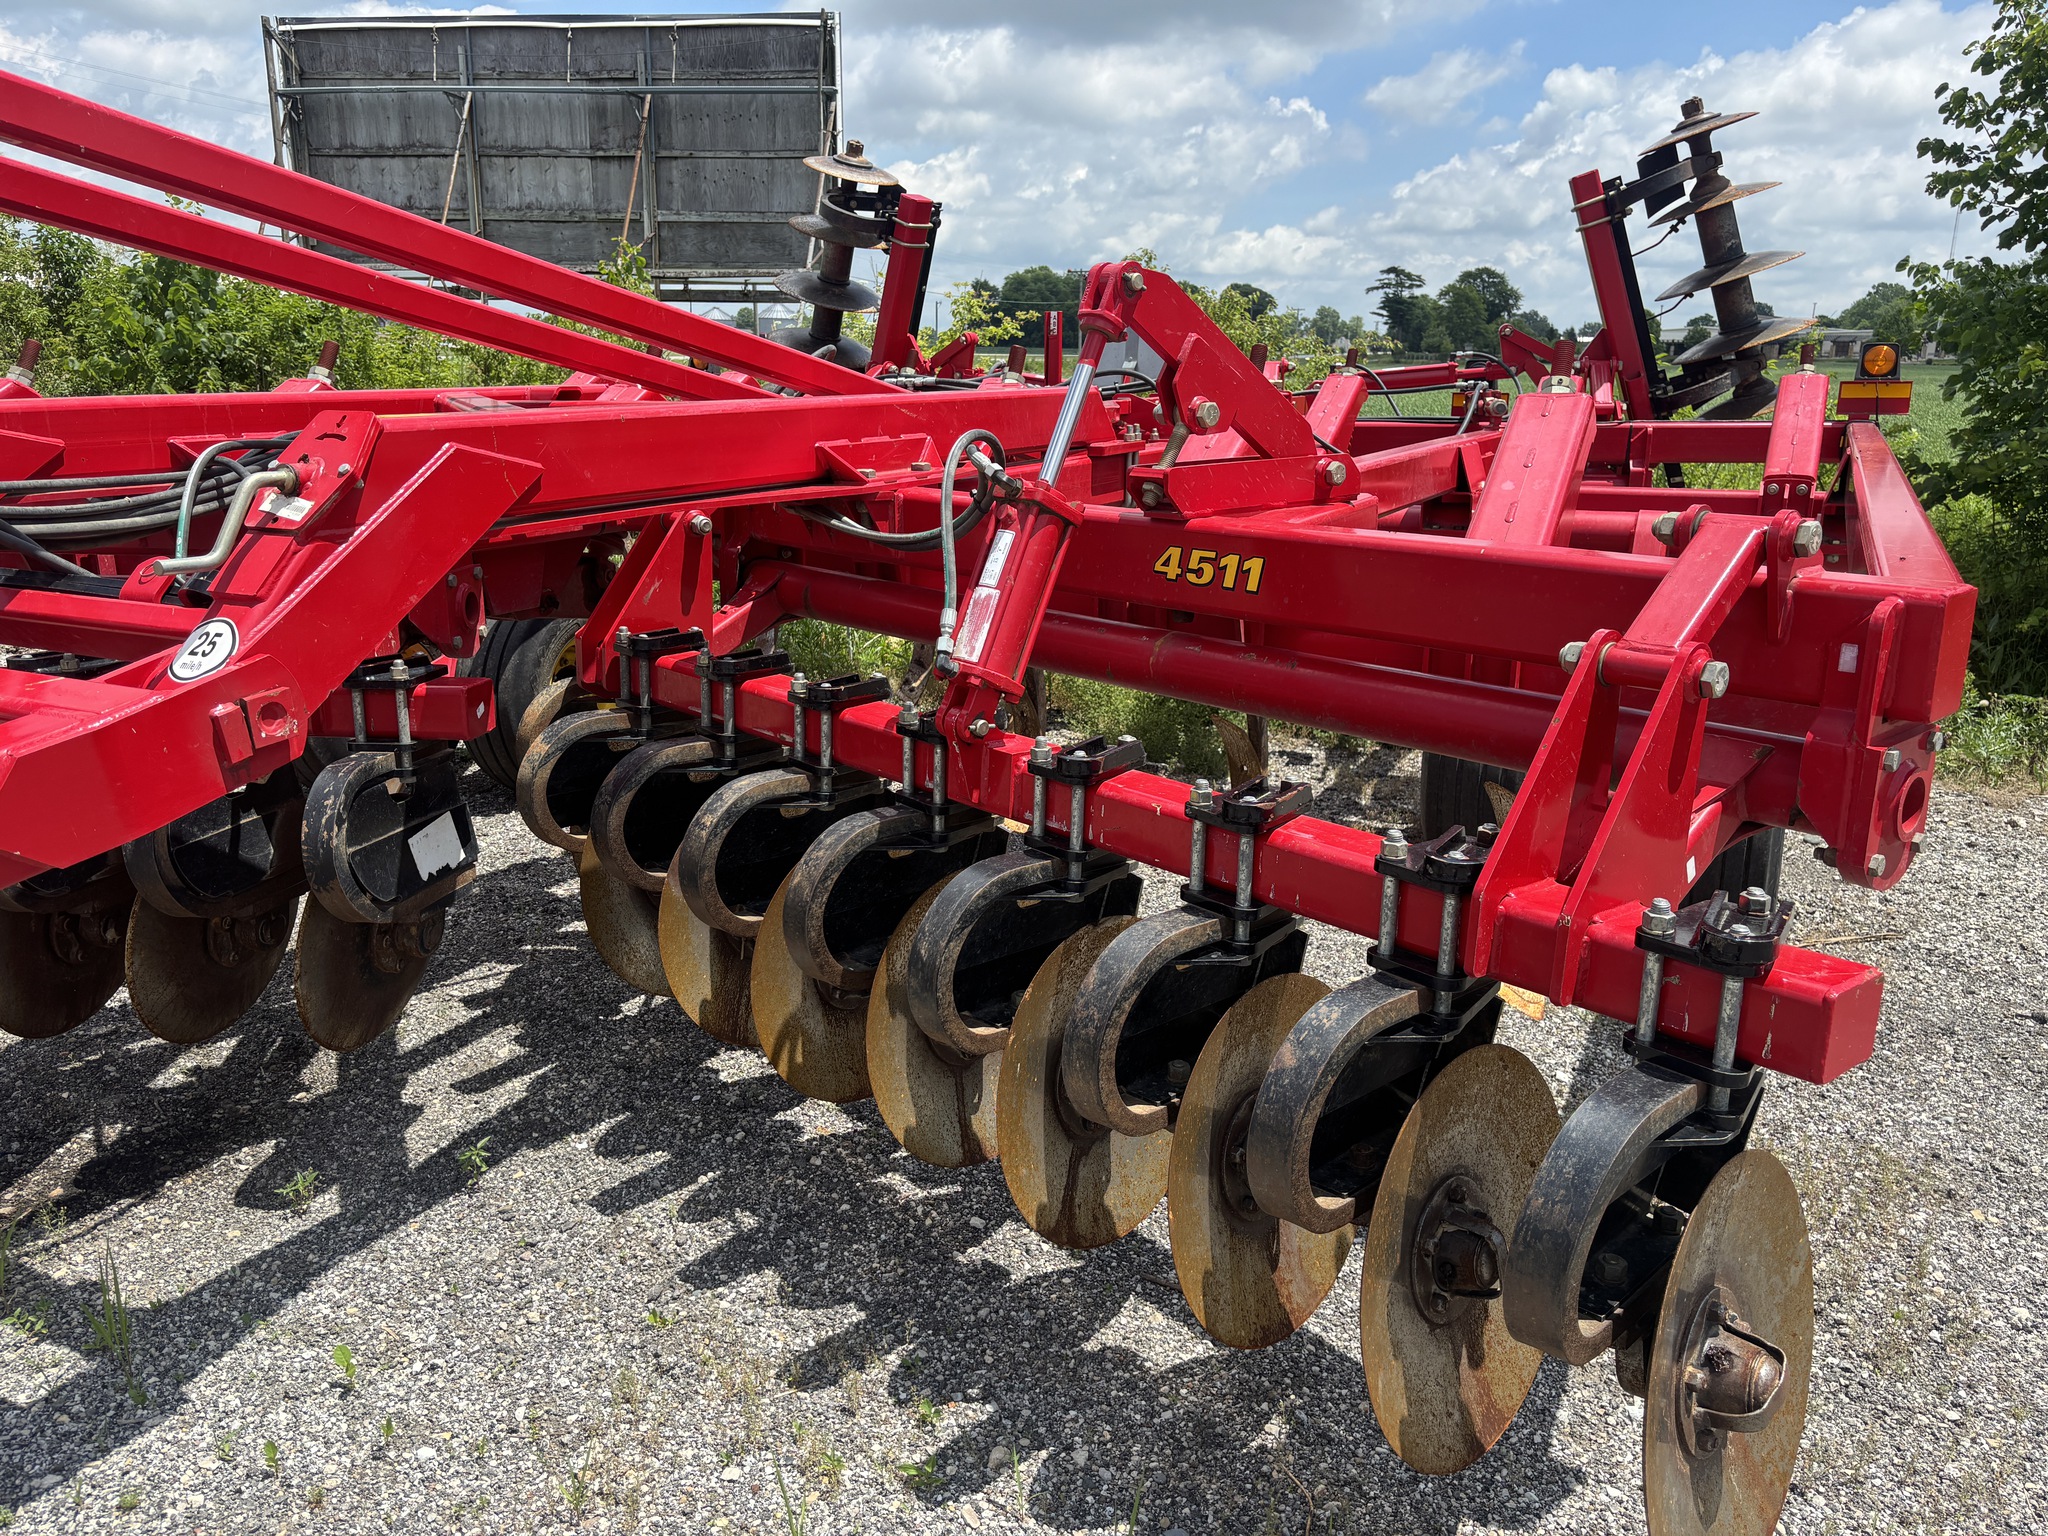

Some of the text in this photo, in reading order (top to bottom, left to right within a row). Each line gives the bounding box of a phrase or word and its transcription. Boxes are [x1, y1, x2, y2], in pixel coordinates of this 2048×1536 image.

[1153, 545, 1265, 595] 4511
[187, 631, 224, 658] 25
[179, 660, 203, 672] mile/h
